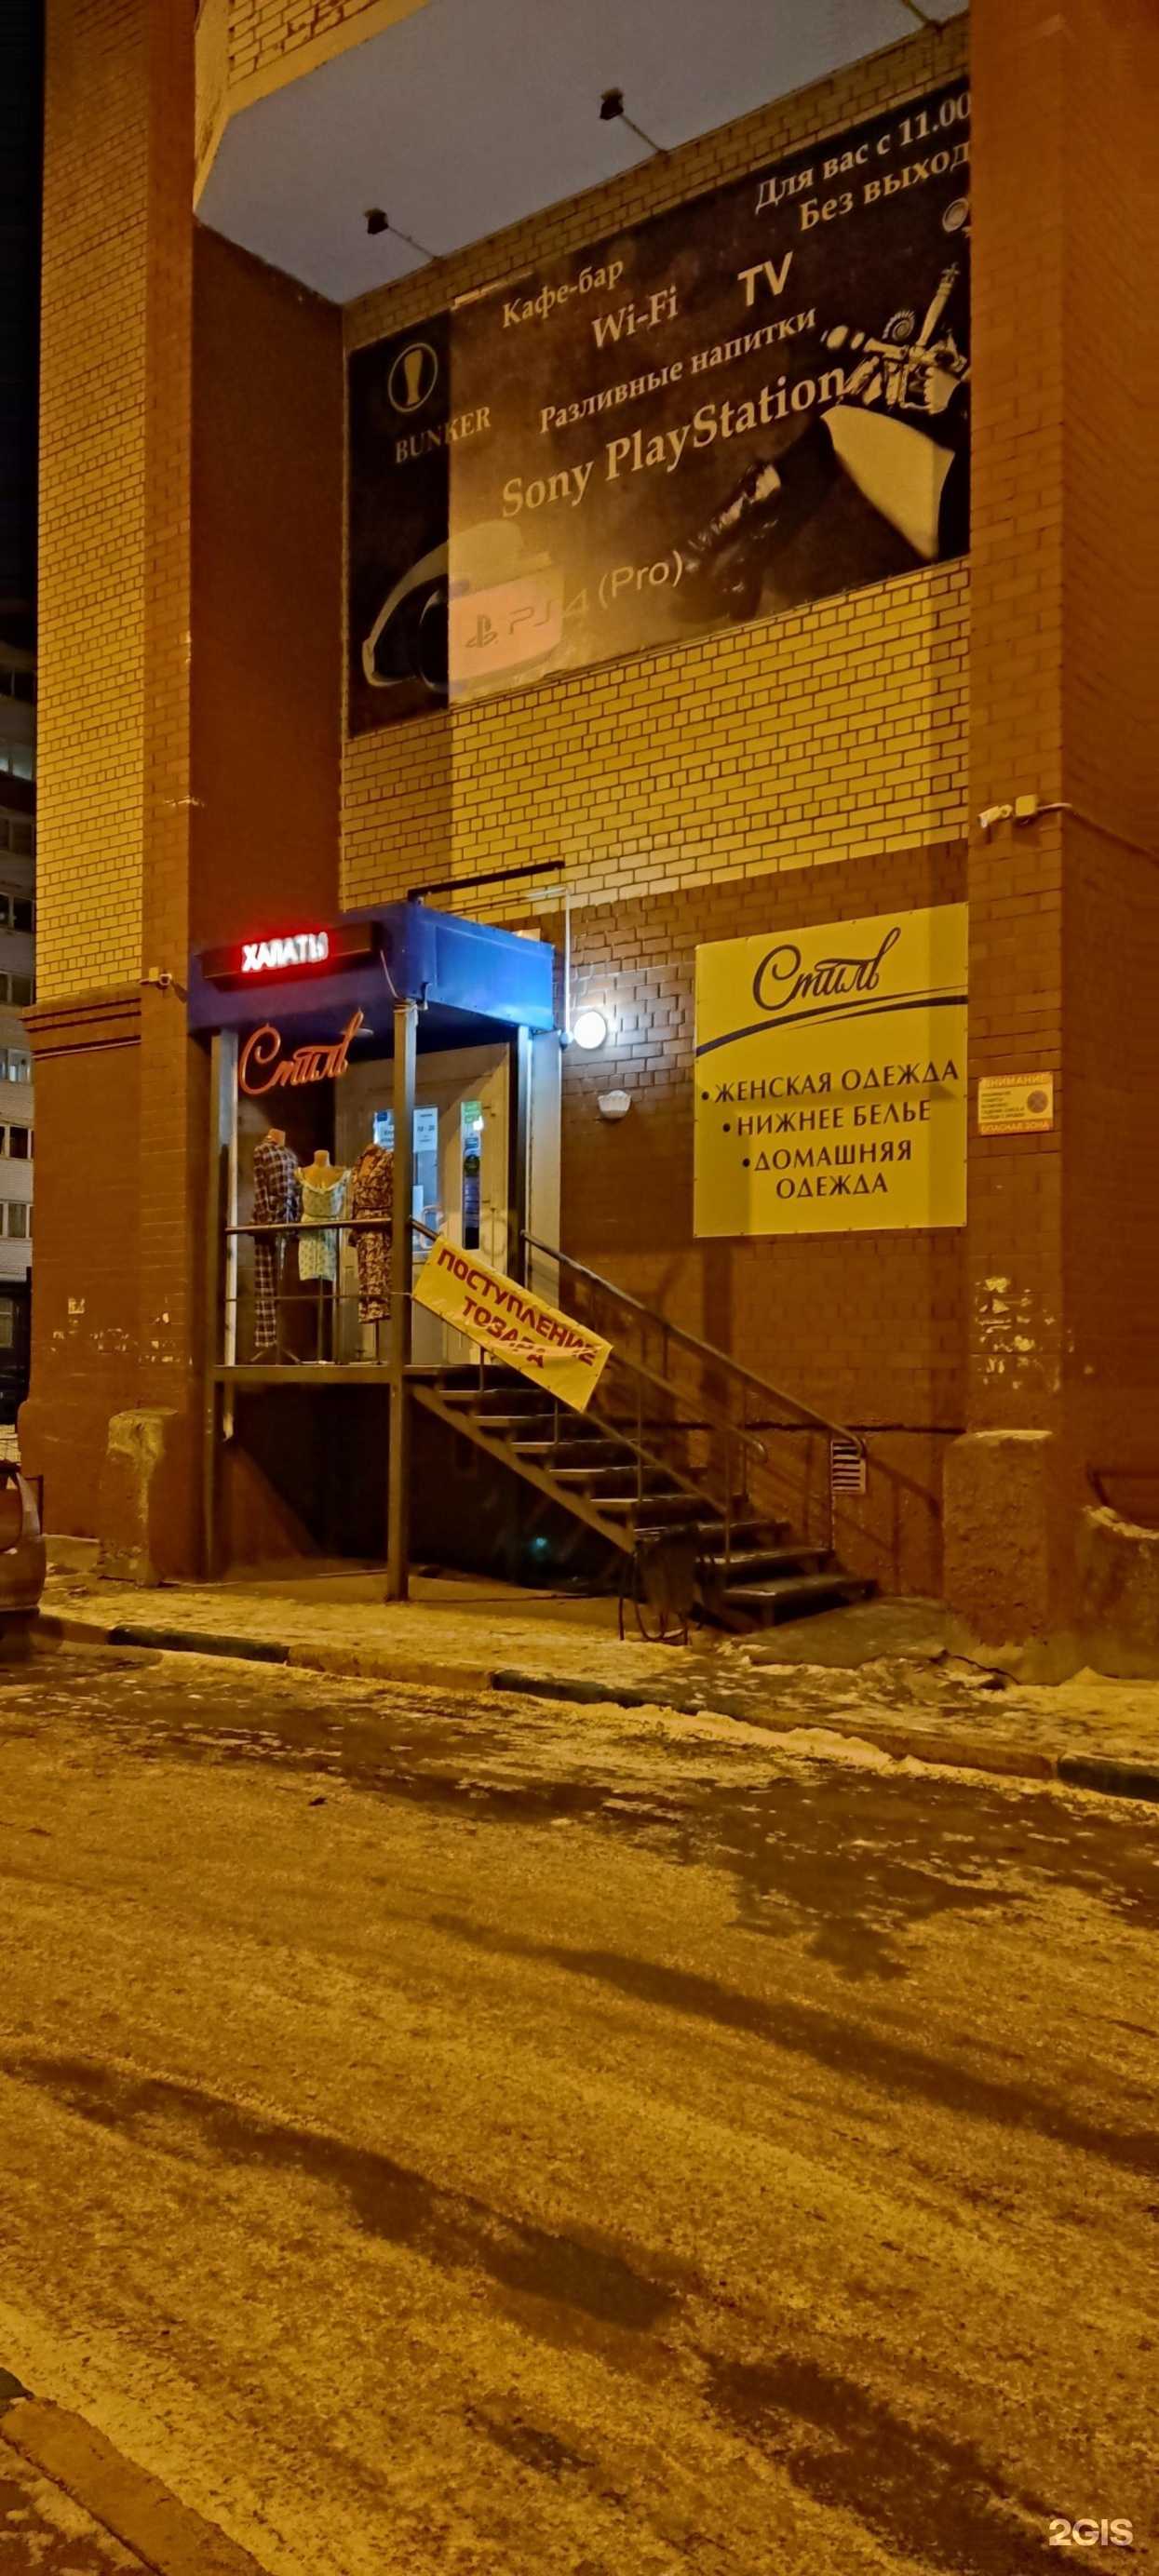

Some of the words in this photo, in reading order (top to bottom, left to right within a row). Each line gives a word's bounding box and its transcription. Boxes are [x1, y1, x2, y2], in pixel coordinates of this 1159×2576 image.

[755, 168, 815, 215] Для
[823, 143, 869, 181] вас
[876, 134, 891, 155] с
[898, 93, 970, 146] 11.00
[800, 192, 854, 231] Без
[502, 261, 624, 328] Кафе-бар
[737, 250, 793, 307] TV
[591, 286, 679, 349] Wi-Fi
[539, 362, 683, 435] Разливные
[691, 308, 815, 374] напитки
[395, 407, 492, 463] BUNKER
[502, 461, 594, 517] Sony
[605, 368, 846, 481] PlayStation
[597, 549, 684, 609] (Pro)
[241, 932, 329, 973] ХАЛАТЫ
[752, 927, 902, 1012] Стиль
[238, 1011, 364, 1095] Стиль
[715, 1072, 832, 1104] ЖЕНСКАЯ
[841, 1059, 960, 1091] ОДЕЖДА
[736, 1105, 844, 1137] НИЖНЕЕ
[853, 1099, 932, 1127] БЕЛЬЕ
[754, 1140, 912, 1172] ДОМАШНЯЯ
[775, 1173, 888, 1200] ОДЕЖДА
[437, 1249, 599, 1366] ПОСТУПЛЕНИЕ
